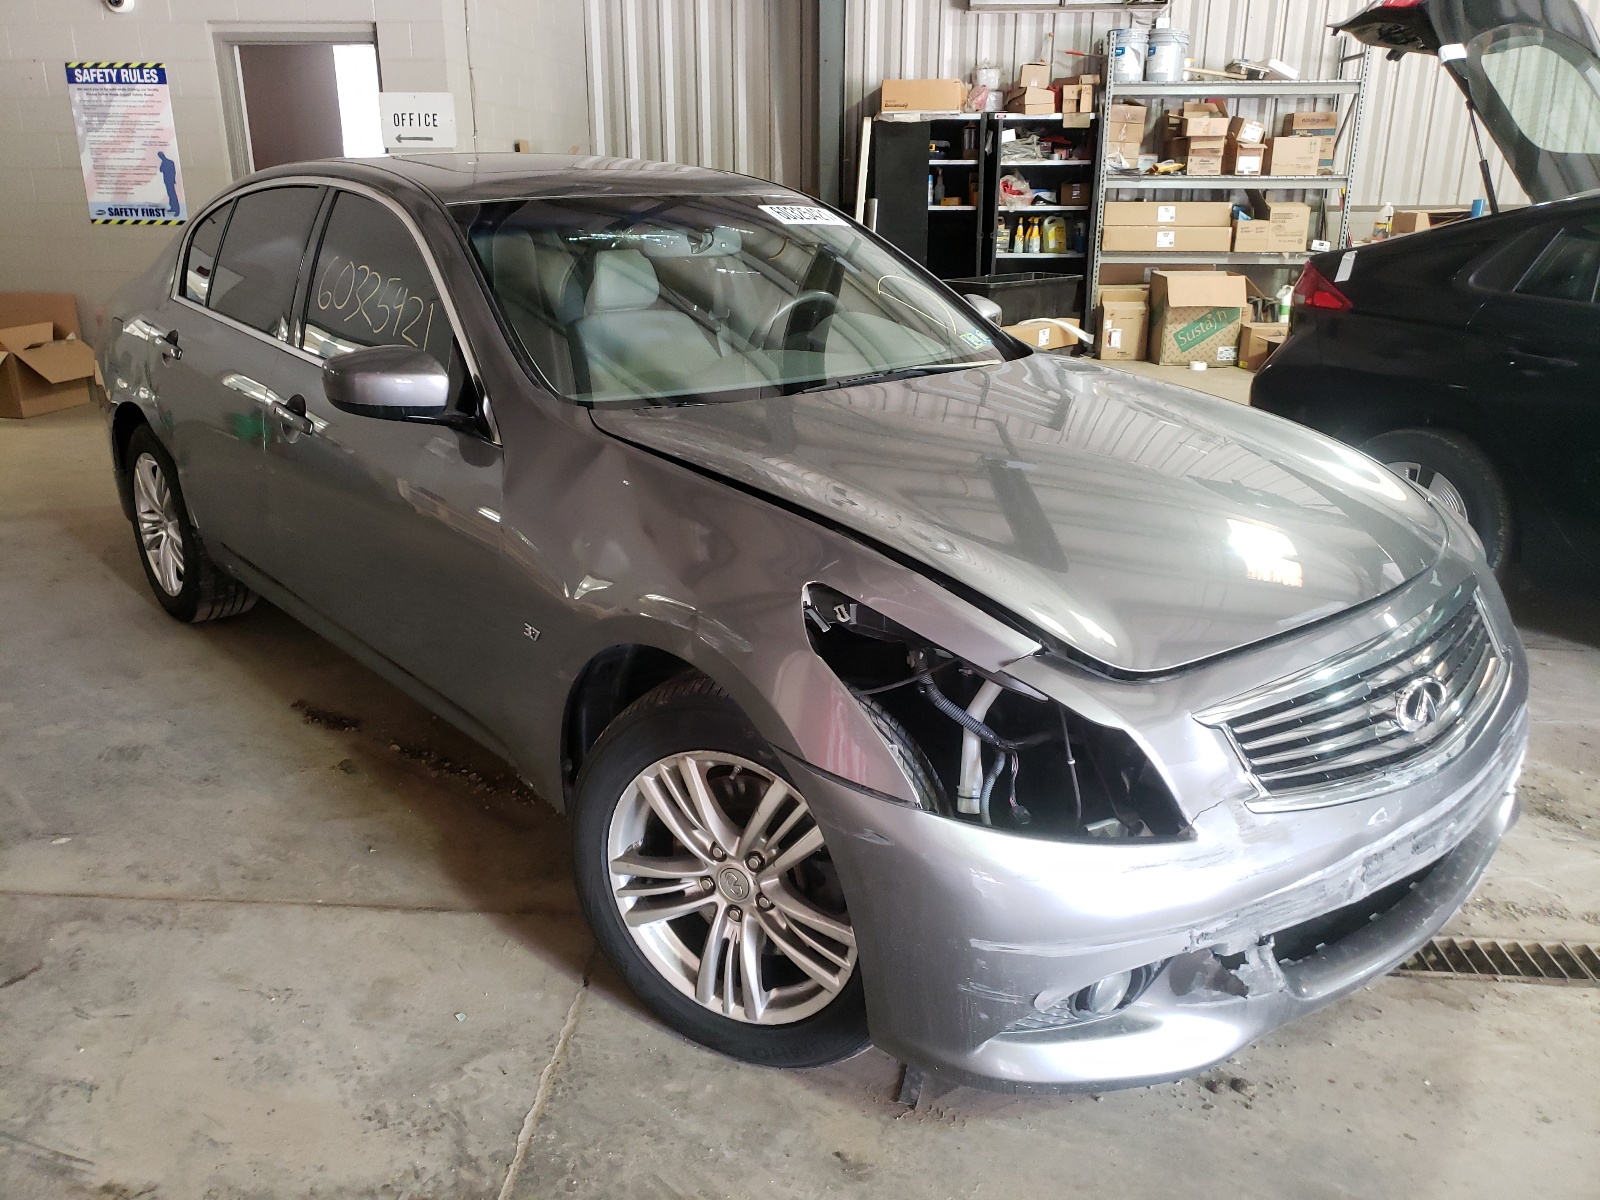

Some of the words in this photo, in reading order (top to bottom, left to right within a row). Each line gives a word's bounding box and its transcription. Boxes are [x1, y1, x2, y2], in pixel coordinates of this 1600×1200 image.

[74, 68, 118, 83] SAFETY
[120, 69, 159, 83] RULES
[393, 112, 439, 128] OFFICE
[107, 207, 139, 217] SAFETY
[141, 208, 166, 218] FIRST
[317, 255, 434, 352] 60325421
